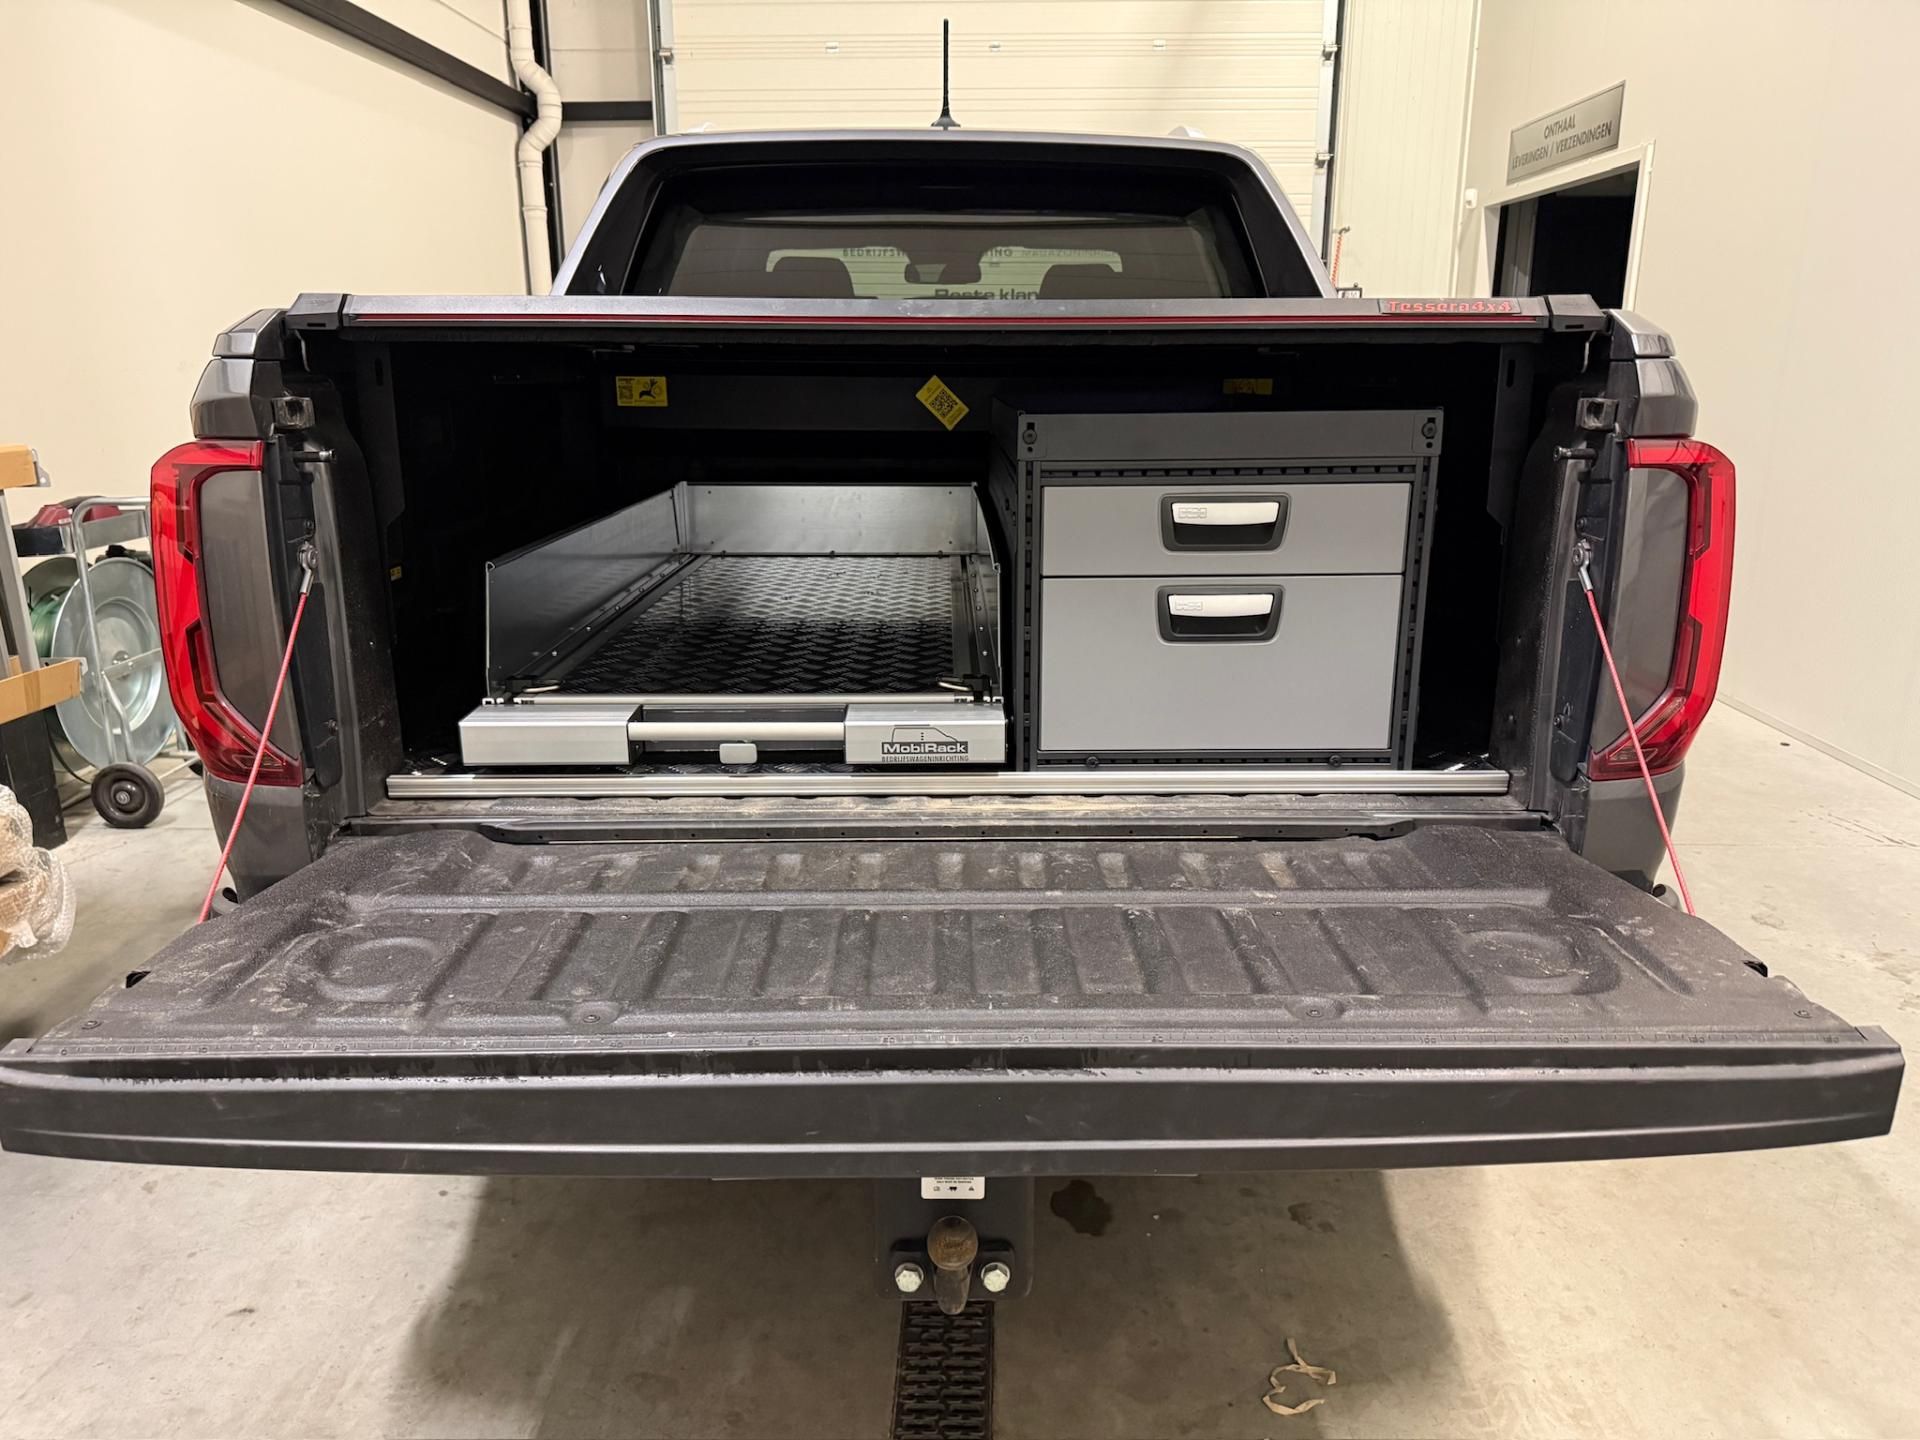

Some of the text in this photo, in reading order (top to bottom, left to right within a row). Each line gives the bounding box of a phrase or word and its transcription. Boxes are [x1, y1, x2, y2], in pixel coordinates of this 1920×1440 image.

[1544, 114, 1576, 139] ONTHAAL
[1512, 146, 1549, 169] LEVERINGEN
[1556, 122, 1612, 153] VERZENDINGEN
[1389, 301, 1512, 312] Tessera4x4
[883, 742, 966, 754] MobiRack
